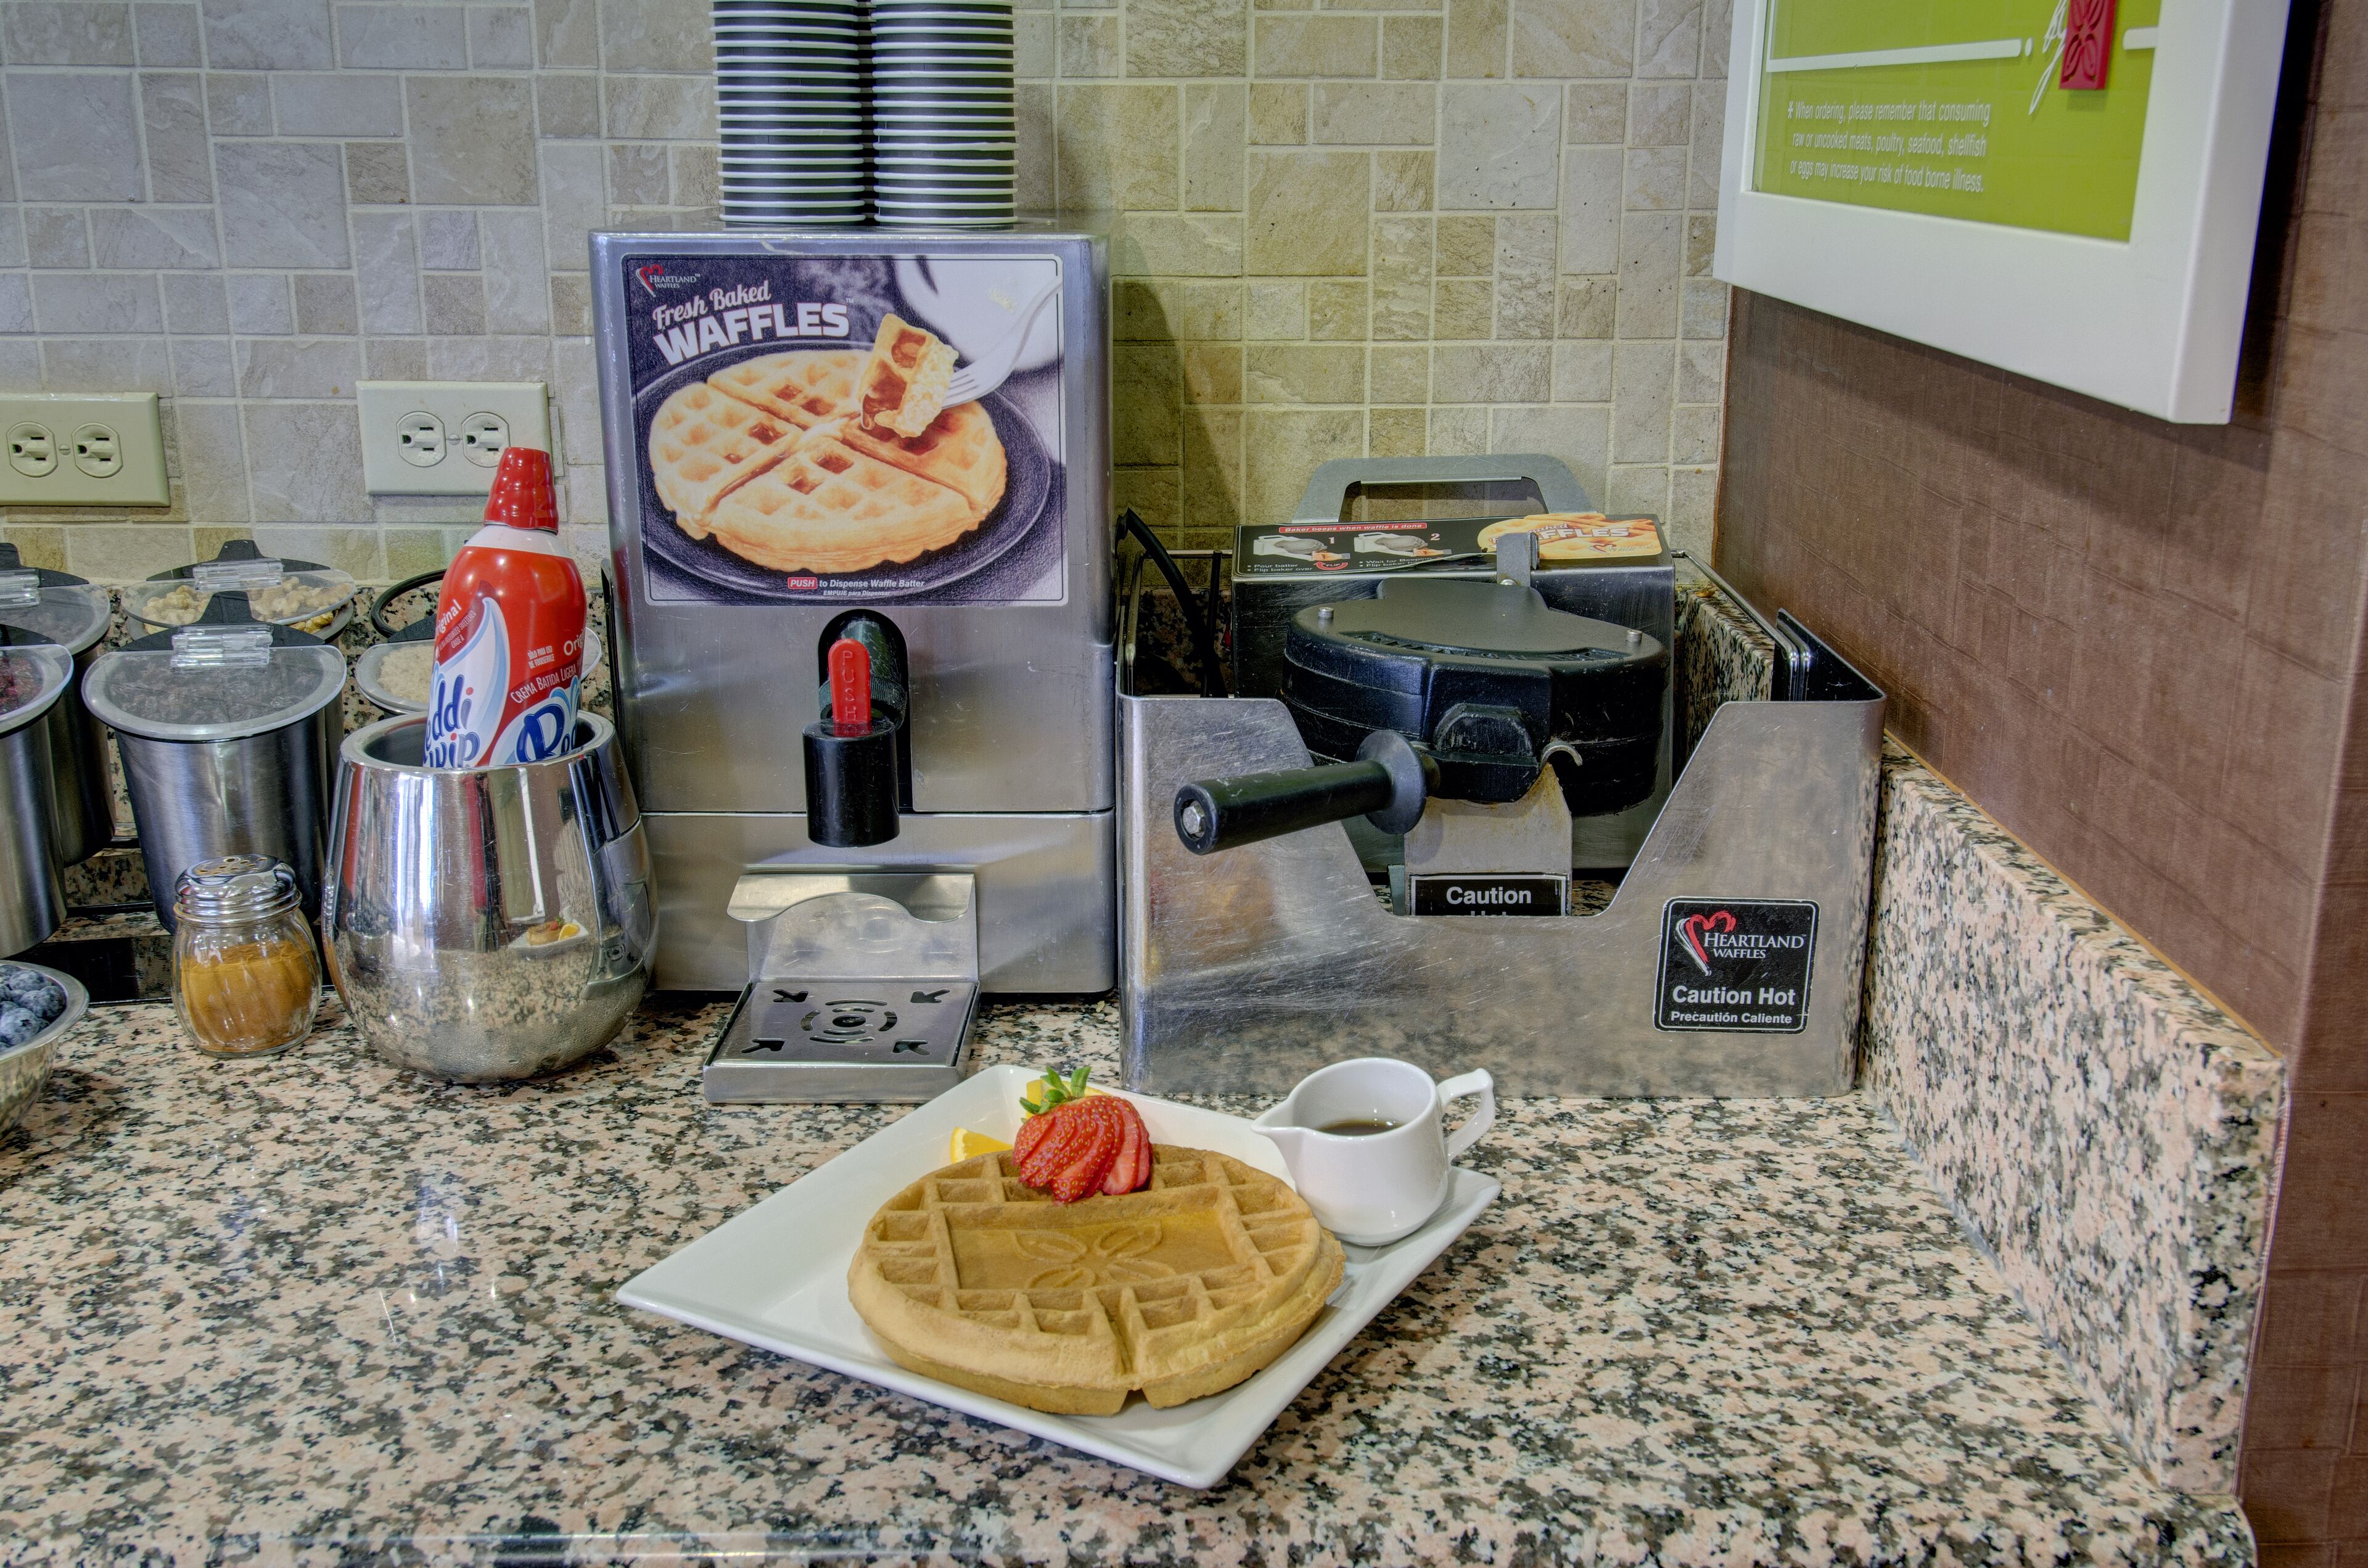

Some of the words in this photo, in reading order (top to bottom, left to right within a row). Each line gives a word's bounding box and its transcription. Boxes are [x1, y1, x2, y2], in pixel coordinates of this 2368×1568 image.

[1796, 101, 1813, 119] When
[1815, 101, 1846, 125] ordering,
[1848, 101, 1873, 123] please
[1875, 99, 1917, 120] remember
[1918, 99, 1937, 121] that
[1938, 98, 1992, 127] consuming
[1793, 133, 1804, 147] raw
[1806, 133, 1813, 147] or
[1815, 130, 1848, 149] uncooked
[1849, 132, 1873, 153] meats,
[1875, 131, 1905, 157] poultry,
[1908, 133, 1944, 158] seafood,
[1948, 133, 1988, 157] shellfish
[1790, 160, 1798, 174] or
[1798, 160, 1814, 179] eggs
[1815, 162, 1828, 181] may
[1830, 159, 1859, 180] increase
[1859, 166, 1877, 185] your
[1878, 163, 1893, 183] risk
[1894, 164, 1904, 184] of
[1904, 164, 1924, 186] food
[1925, 166, 1951, 189] borne
[1952, 168, 1984, 192] illness.
[649, 275, 697, 283] HEARTLAND
[652, 295, 708, 330] Fresh
[709, 280, 772, 311] Baked
[652, 302, 850, 366] WAFFLES
[1538, 528, 1629, 540] FFLES
[819, 580, 828, 588] to
[829, 580, 868, 589] Dispense
[870, 580, 897, 588] Waffle
[898, 580, 925, 588] Batter
[435, 599, 462, 636] riginal
[528, 660, 535, 669] DE
[510, 682, 538, 703] CREMA
[535, 672, 561, 691] BATIDA
[560, 663, 577, 681] LIGERA
[841, 651, 857, 721] PUSH
[426, 674, 474, 751] eddi
[1446, 886, 1532, 905] Caution
[1703, 932, 1804, 949] HEARTLAND
[1712, 948, 1767, 959] WAFFLES
[1672, 985, 1752, 1005] Caution
[1758, 987, 1796, 1006] Hot
[1741, 1013, 1793, 1024] Caliente
